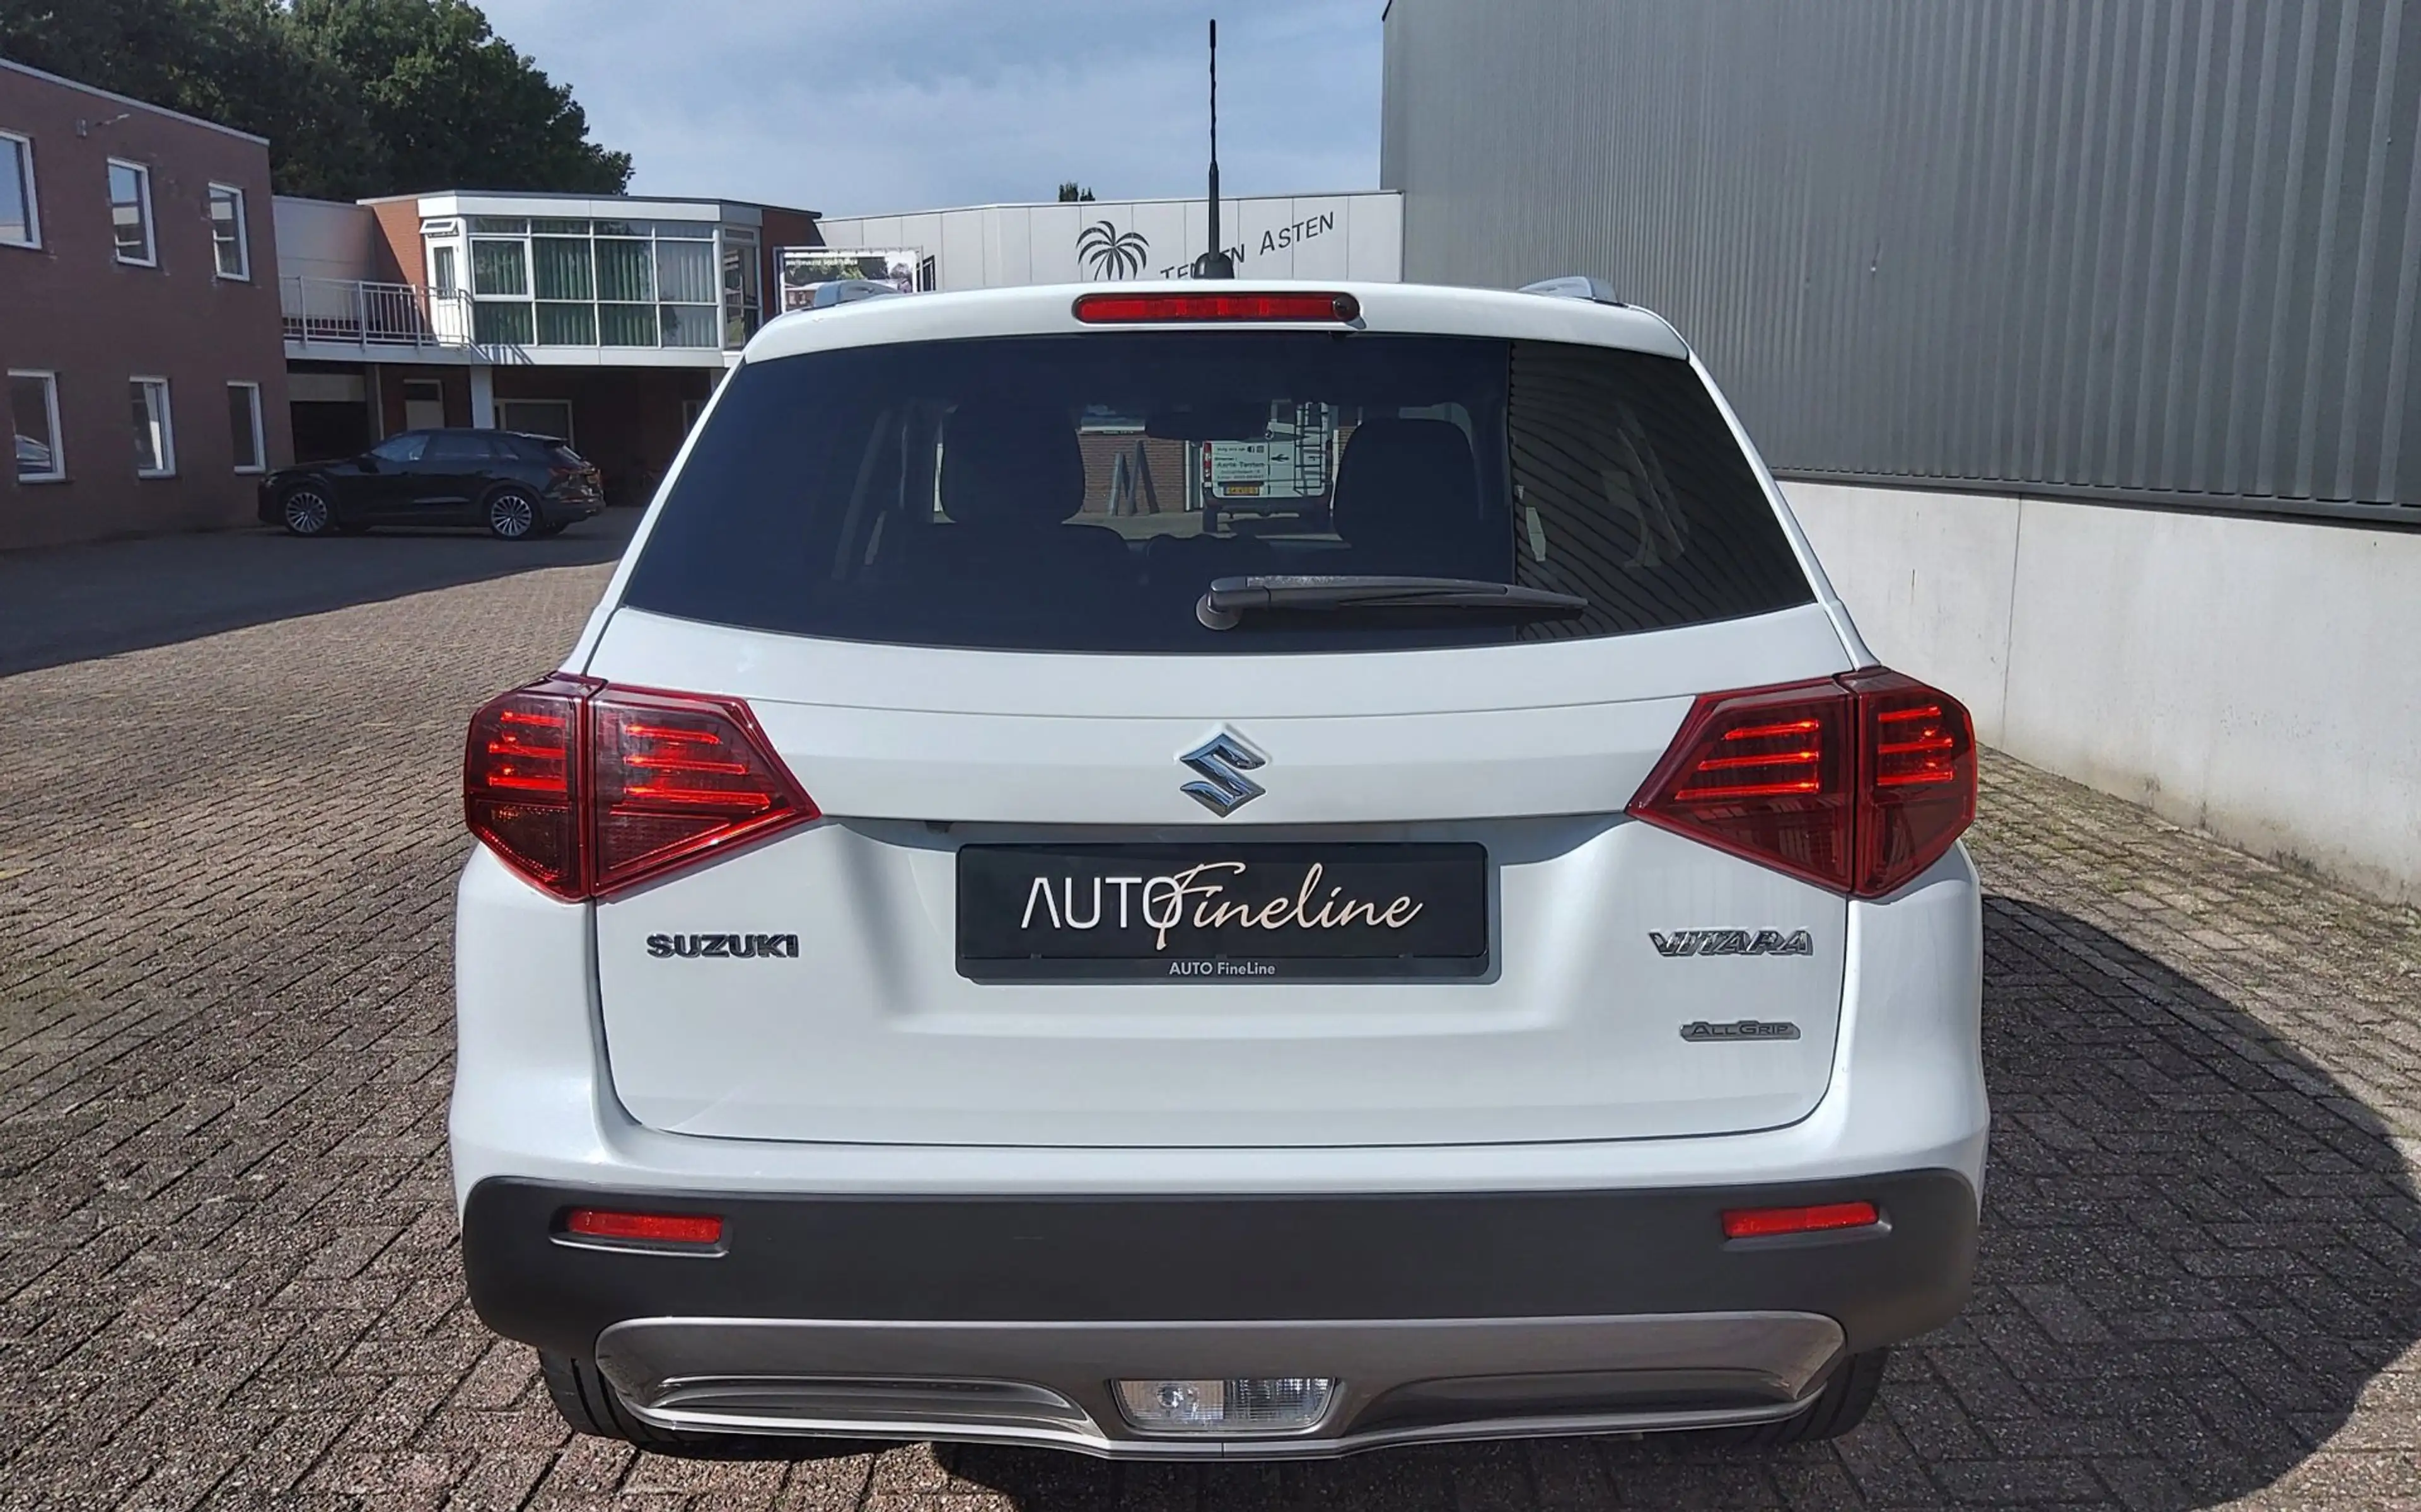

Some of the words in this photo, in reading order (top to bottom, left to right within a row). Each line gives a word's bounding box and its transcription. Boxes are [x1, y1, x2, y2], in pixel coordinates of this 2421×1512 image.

[1260, 211, 1333, 255] ASTEN
[646, 933, 799, 958] SUZUKI
[1647, 930, 1813, 957] VITARA
[1169, 961, 1213, 975] AUTO
[1217, 961, 1275, 975] FineLine
